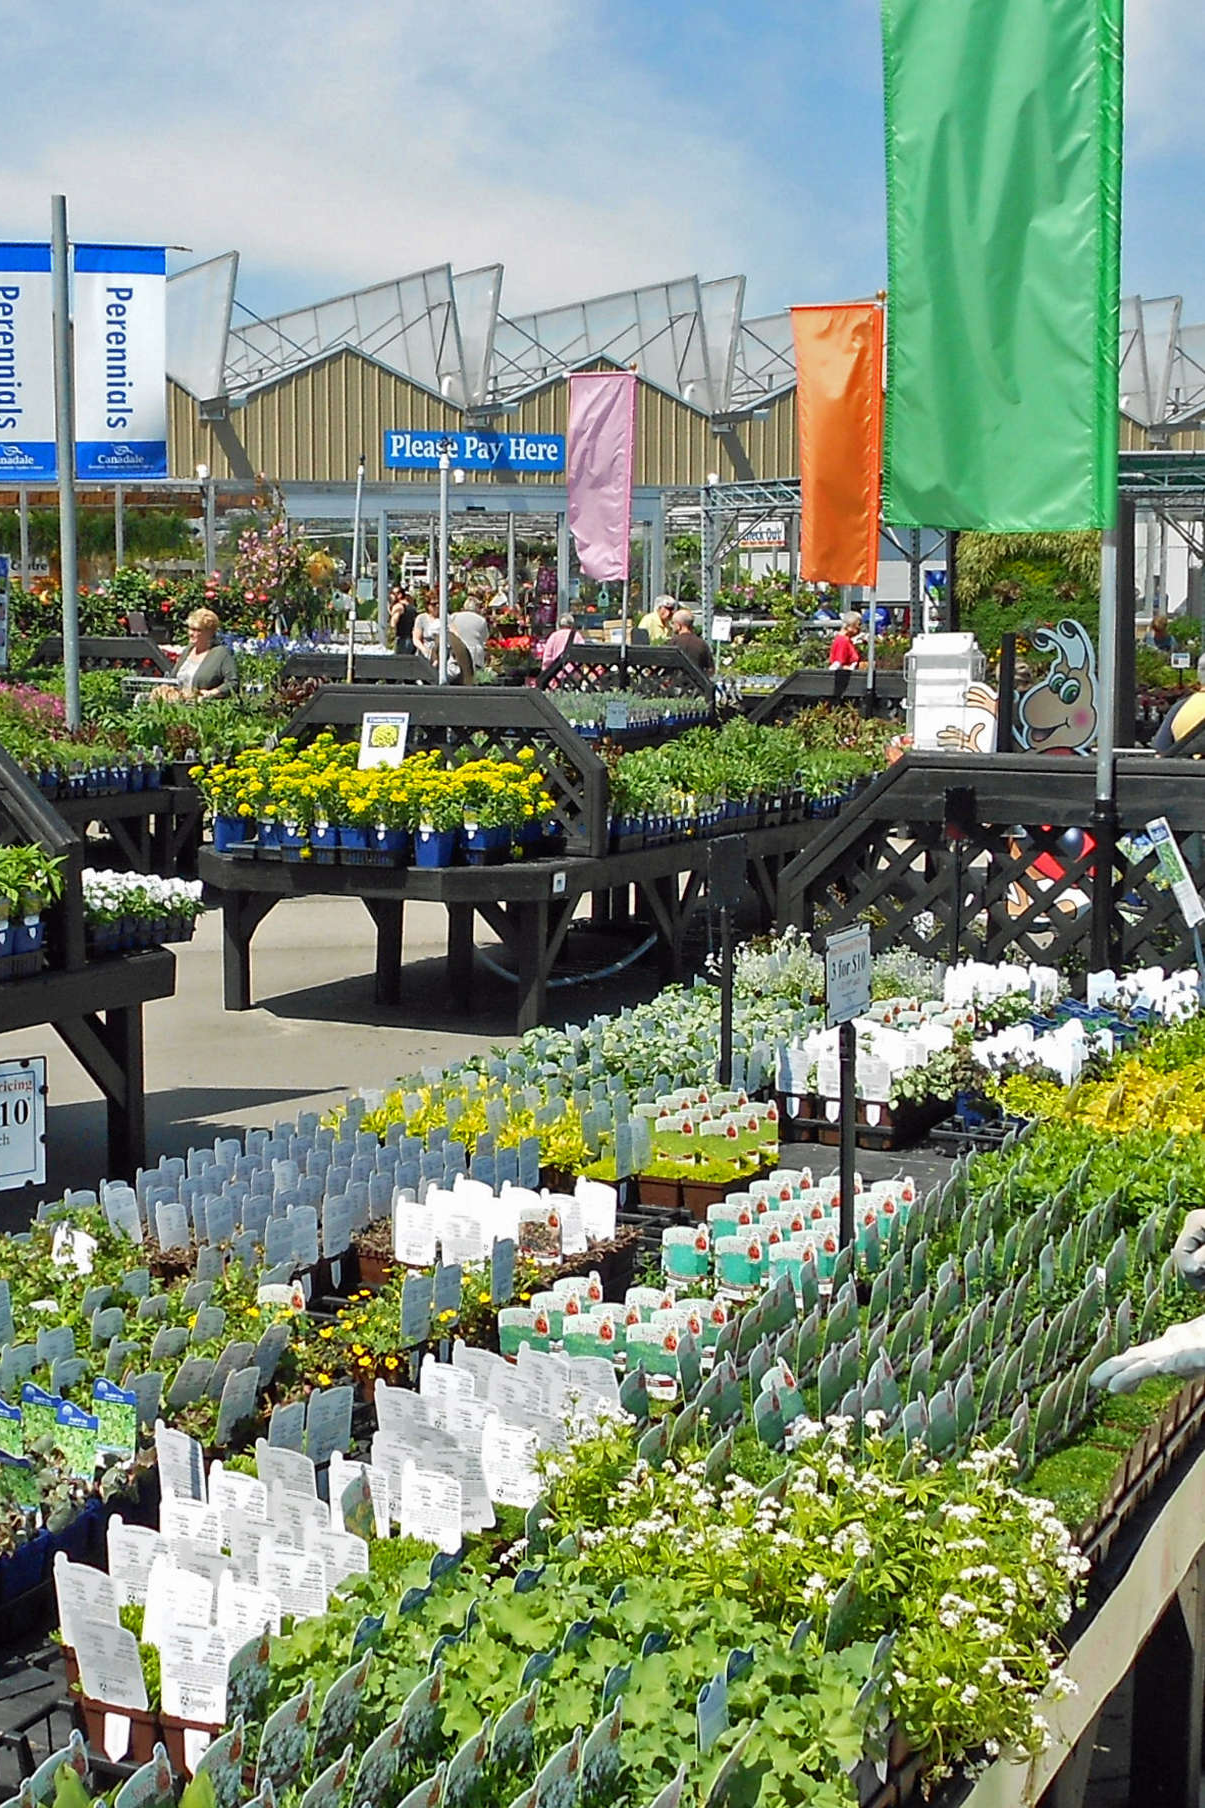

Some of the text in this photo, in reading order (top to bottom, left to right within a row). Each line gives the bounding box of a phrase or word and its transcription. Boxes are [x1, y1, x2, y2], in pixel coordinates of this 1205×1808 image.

[106, 286, 134, 429] Perennials
[97, 454, 145, 465] Canadale
[390, 434, 558, 464] Please Pay Here
